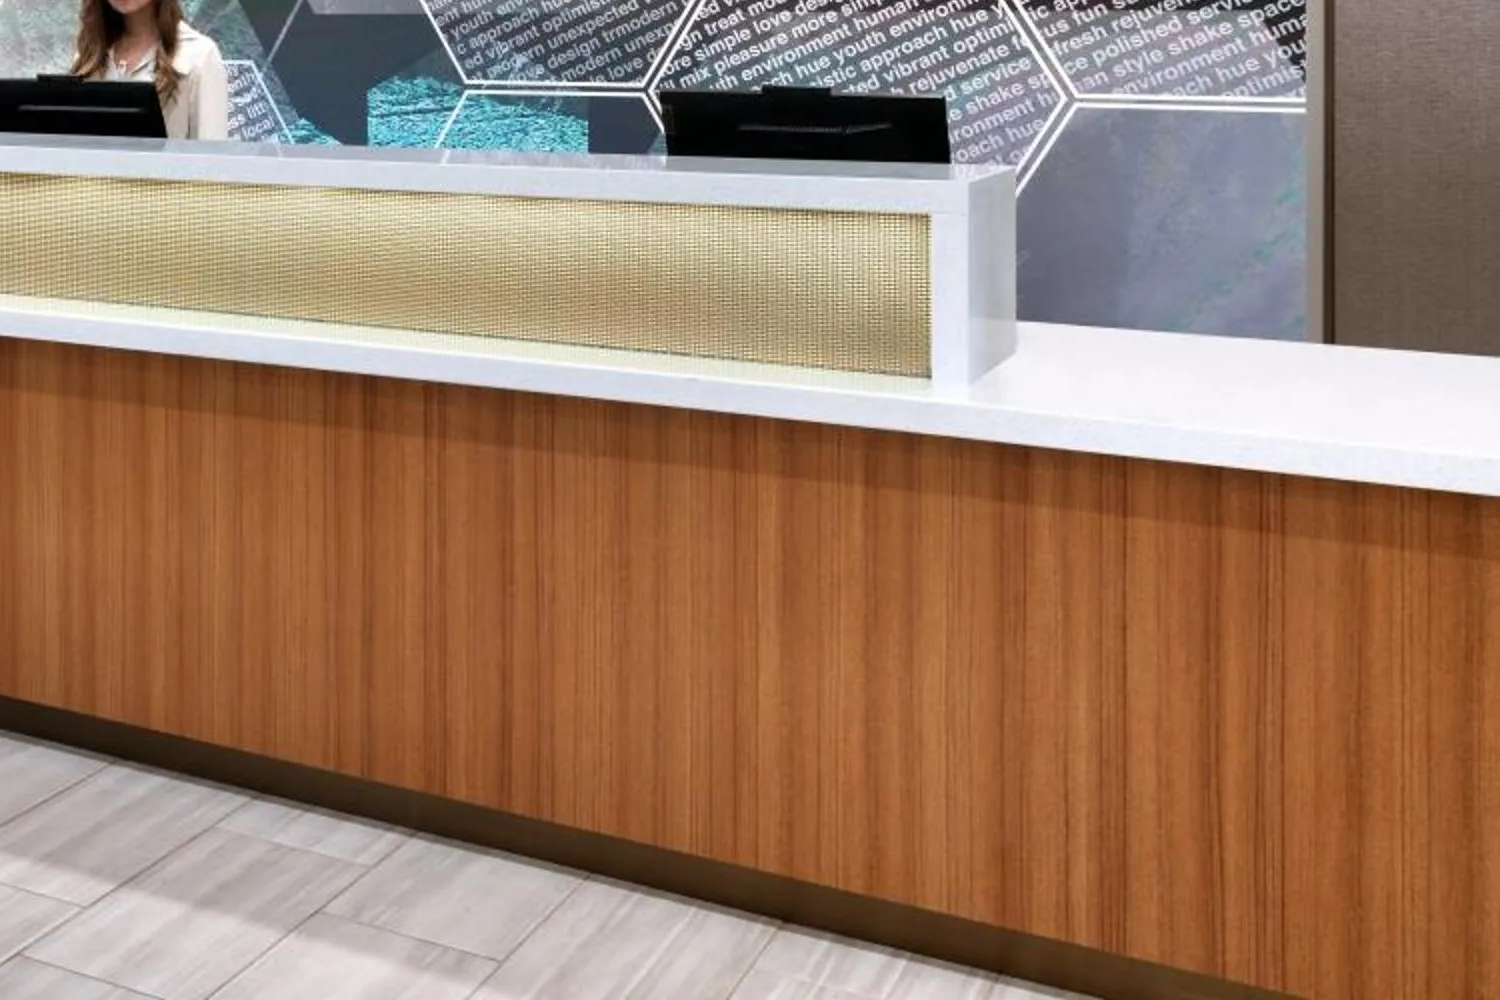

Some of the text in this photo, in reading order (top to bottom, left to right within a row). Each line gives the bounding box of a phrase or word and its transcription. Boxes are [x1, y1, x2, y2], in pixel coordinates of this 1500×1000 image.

[450, 7, 494, 42] youth
[467, 3, 540, 48] approach
[545, 2, 673, 68] design trmodern
[693, 27, 751, 61] simple
[752, 9, 792, 34] love
[702, 6, 745, 35] treat
[1070, 1, 1109, 26] fun
[678, 65, 712, 88] mix
[713, 31, 788, 76] pleasure
[790, 9, 839, 38] more
[740, 22, 852, 81] environment
[793, 55, 830, 78] hue
[832, 27, 887, 65] youth
[859, 9, 989, 72] approach hue
[1091, 14, 1183, 67] polished
[1111, 47, 1166, 78] style
[1167, 20, 1234, 55] shake
[559, 46, 622, 83] modern
[605, 55, 644, 79] love
[882, 45, 950, 84] vibrant
[908, 44, 1010, 95] rejuvenate
[960, 58, 1031, 95] service
[1214, 56, 1261, 83] hue
[966, 82, 1025, 114] shake
